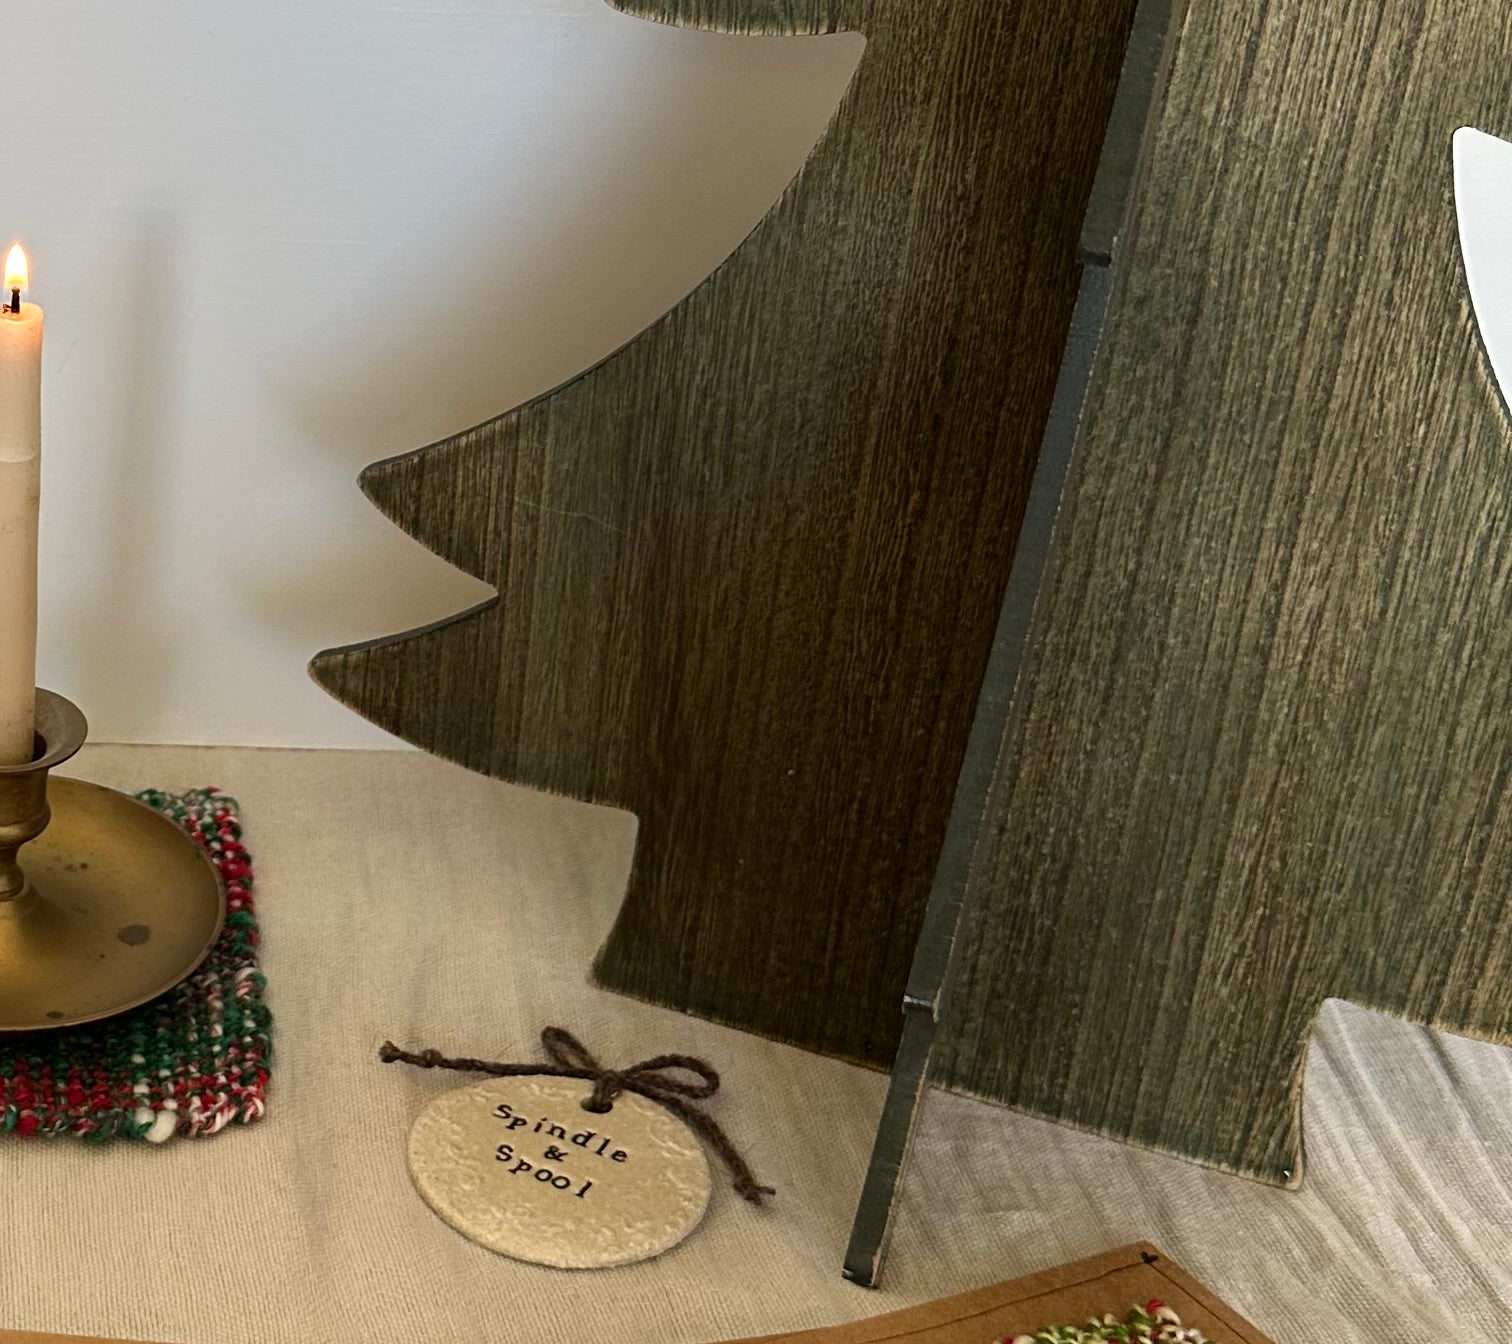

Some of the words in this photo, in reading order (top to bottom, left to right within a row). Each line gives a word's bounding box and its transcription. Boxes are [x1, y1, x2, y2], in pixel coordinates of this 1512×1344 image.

[492, 1103, 628, 1163] Spindle
[543, 1144, 569, 1162] &
[494, 1143, 593, 1199] Spool
